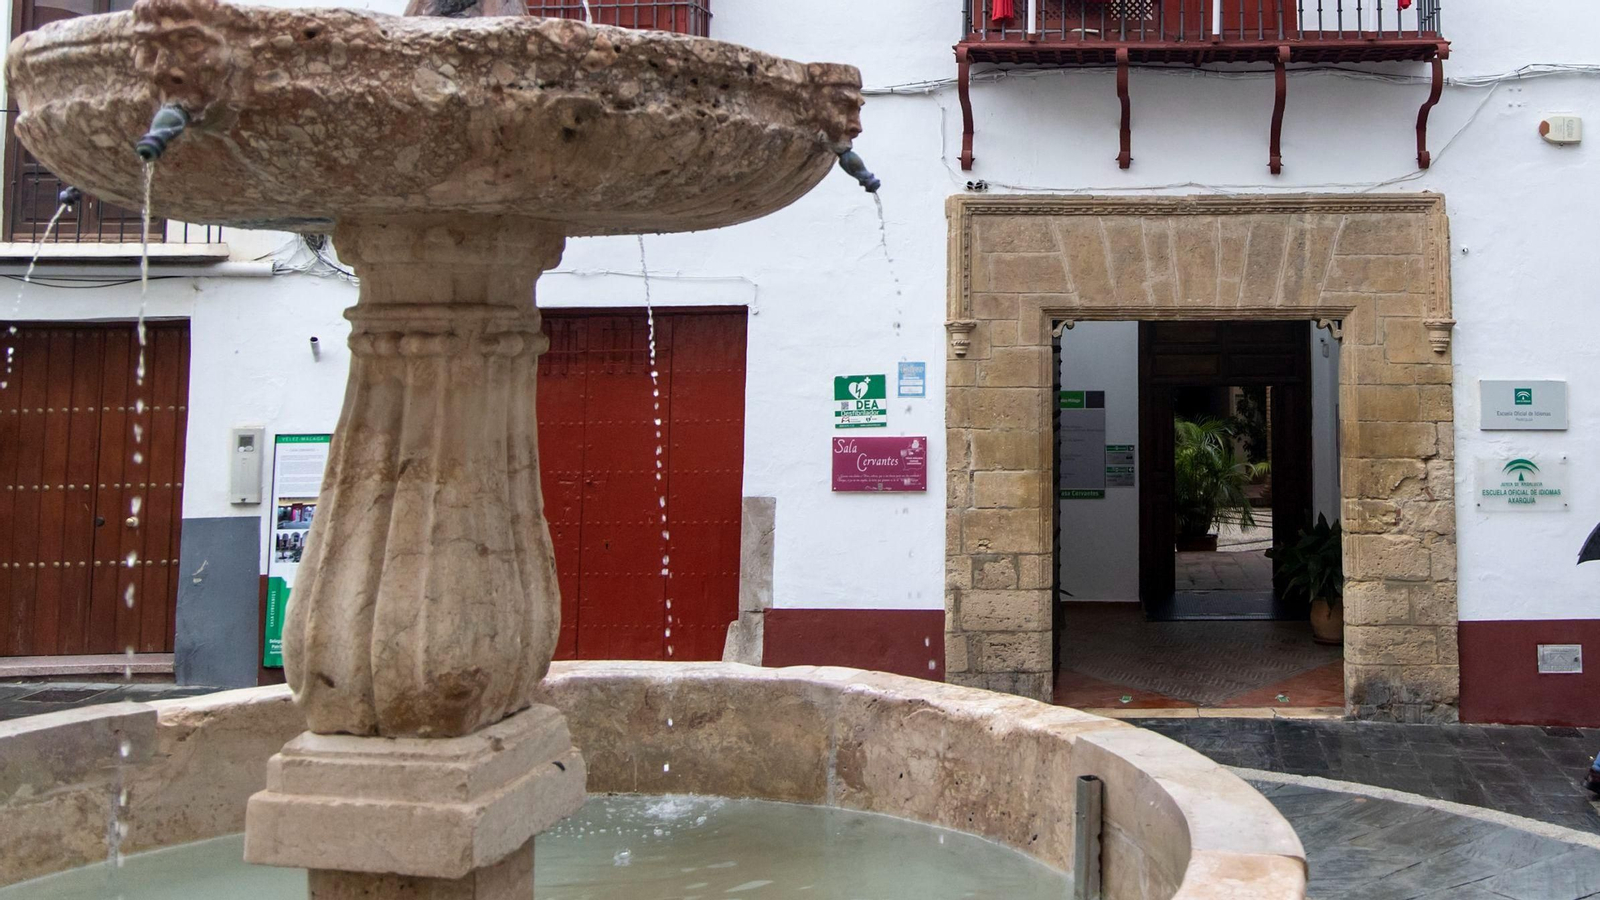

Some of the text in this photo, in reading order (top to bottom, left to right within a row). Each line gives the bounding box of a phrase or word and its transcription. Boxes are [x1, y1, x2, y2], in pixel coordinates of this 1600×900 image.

[856, 400, 879, 409] DEA
[834, 439, 857, 453] Sala
[857, 453, 899, 471] Cervantes
